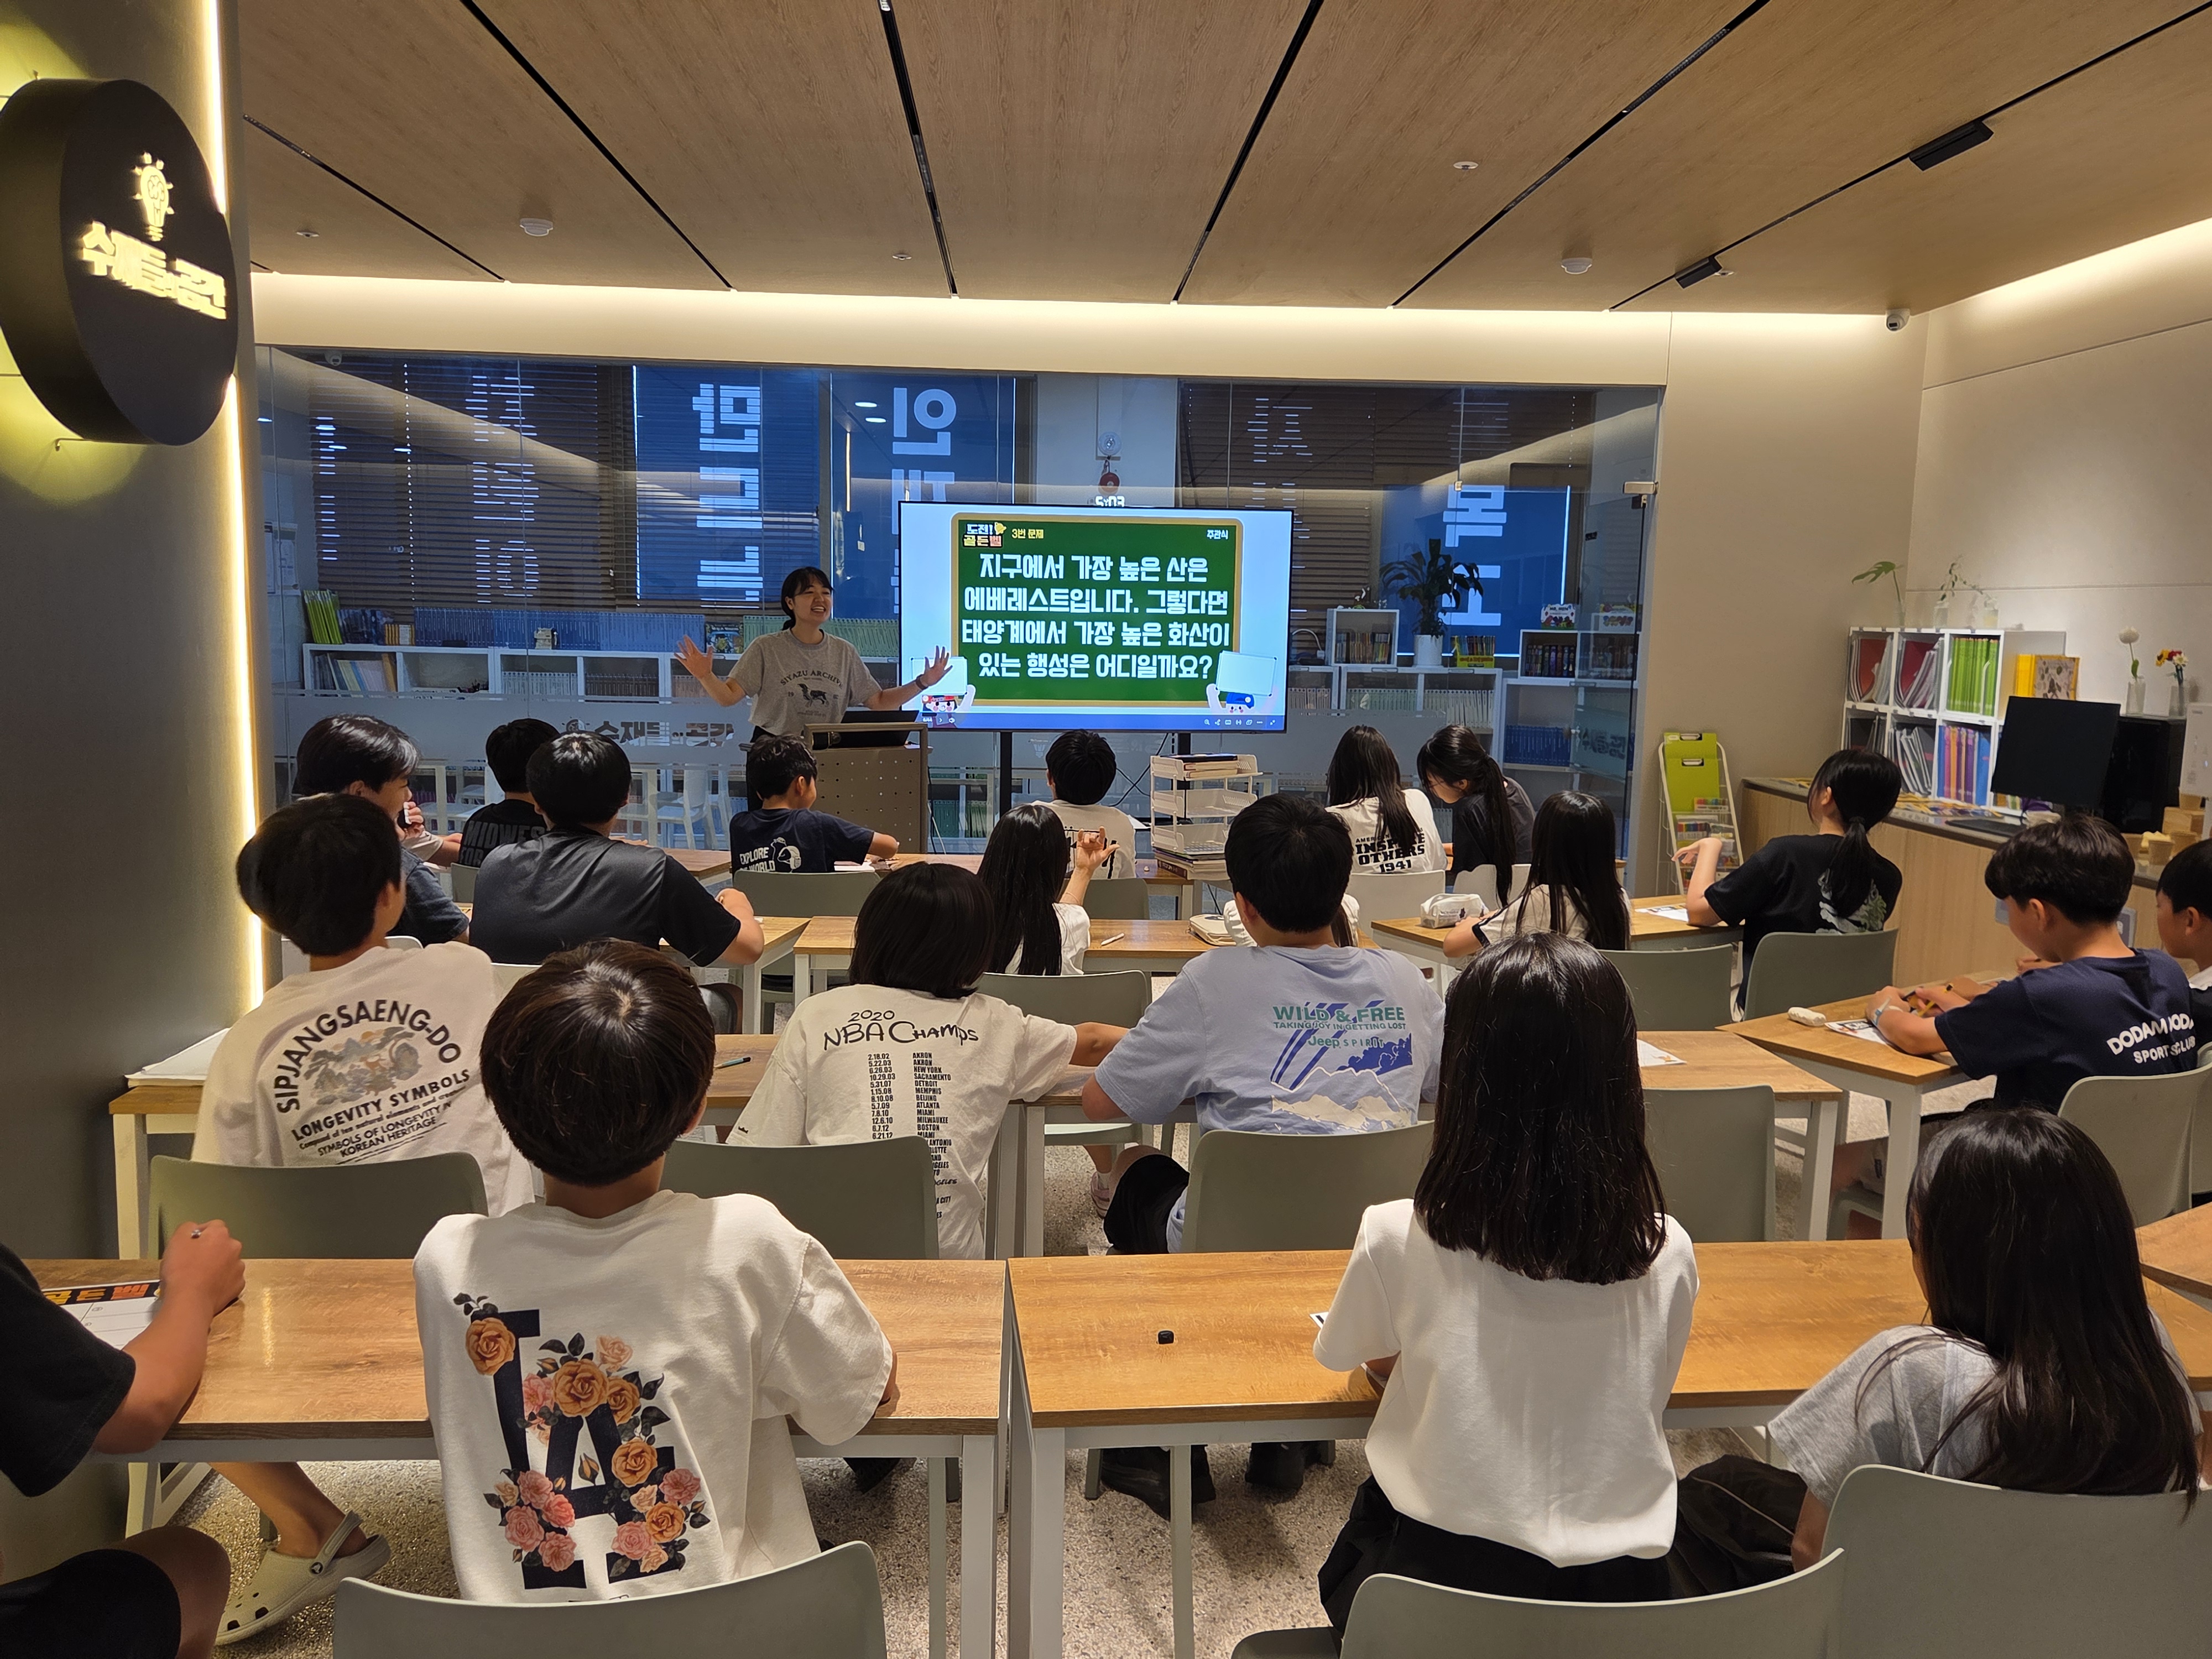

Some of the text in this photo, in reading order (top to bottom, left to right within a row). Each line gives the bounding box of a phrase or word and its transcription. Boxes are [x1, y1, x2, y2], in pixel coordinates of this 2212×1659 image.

[967, 523, 993, 535] 도전!
[1011, 528, 1044, 539] 3번 문제
[1207, 529, 1228, 540] 주관식
[963, 534, 1002, 547] 골든벨
[980, 554, 1208, 582] 지구에서 가장 높은 산은
[964, 587, 1228, 615] 에베레스트입니다. 그렇다면
[962, 619, 1229, 647] 태양계에서 가장 높은 화산이
[979, 653, 1212, 679] 있는 행성은 어디일까요?
[780, 670, 808, 686] SIYAZU
[463, 820, 545, 854] MIDWES
[739, 847, 769, 865] EXPLORE
[1358, 844, 1425, 865] OTHERS
[1380, 859, 1411, 873] 1941
[847, 1009, 895, 1022] 2020
[1272, 1005, 1405, 1022] WILD & FREE
[823, 1021, 885, 1051] NBA
[1308, 1035, 1384, 1048] Jeep SPIRIT
[870, 1073, 951, 1081] 10.29.03 SACRAMENTO
[291, 1068, 470, 1141] LONGEVITY SYMBOLS
[871, 1094, 894, 1103] 8.10.08
[317, 1134, 362, 1156] SYMBOLS
[363, 1127, 379, 1140] OF
[380, 1106, 441, 1134] LONGEVITY
[340, 1115, 437, 1158] KOREAN HERITAGE
